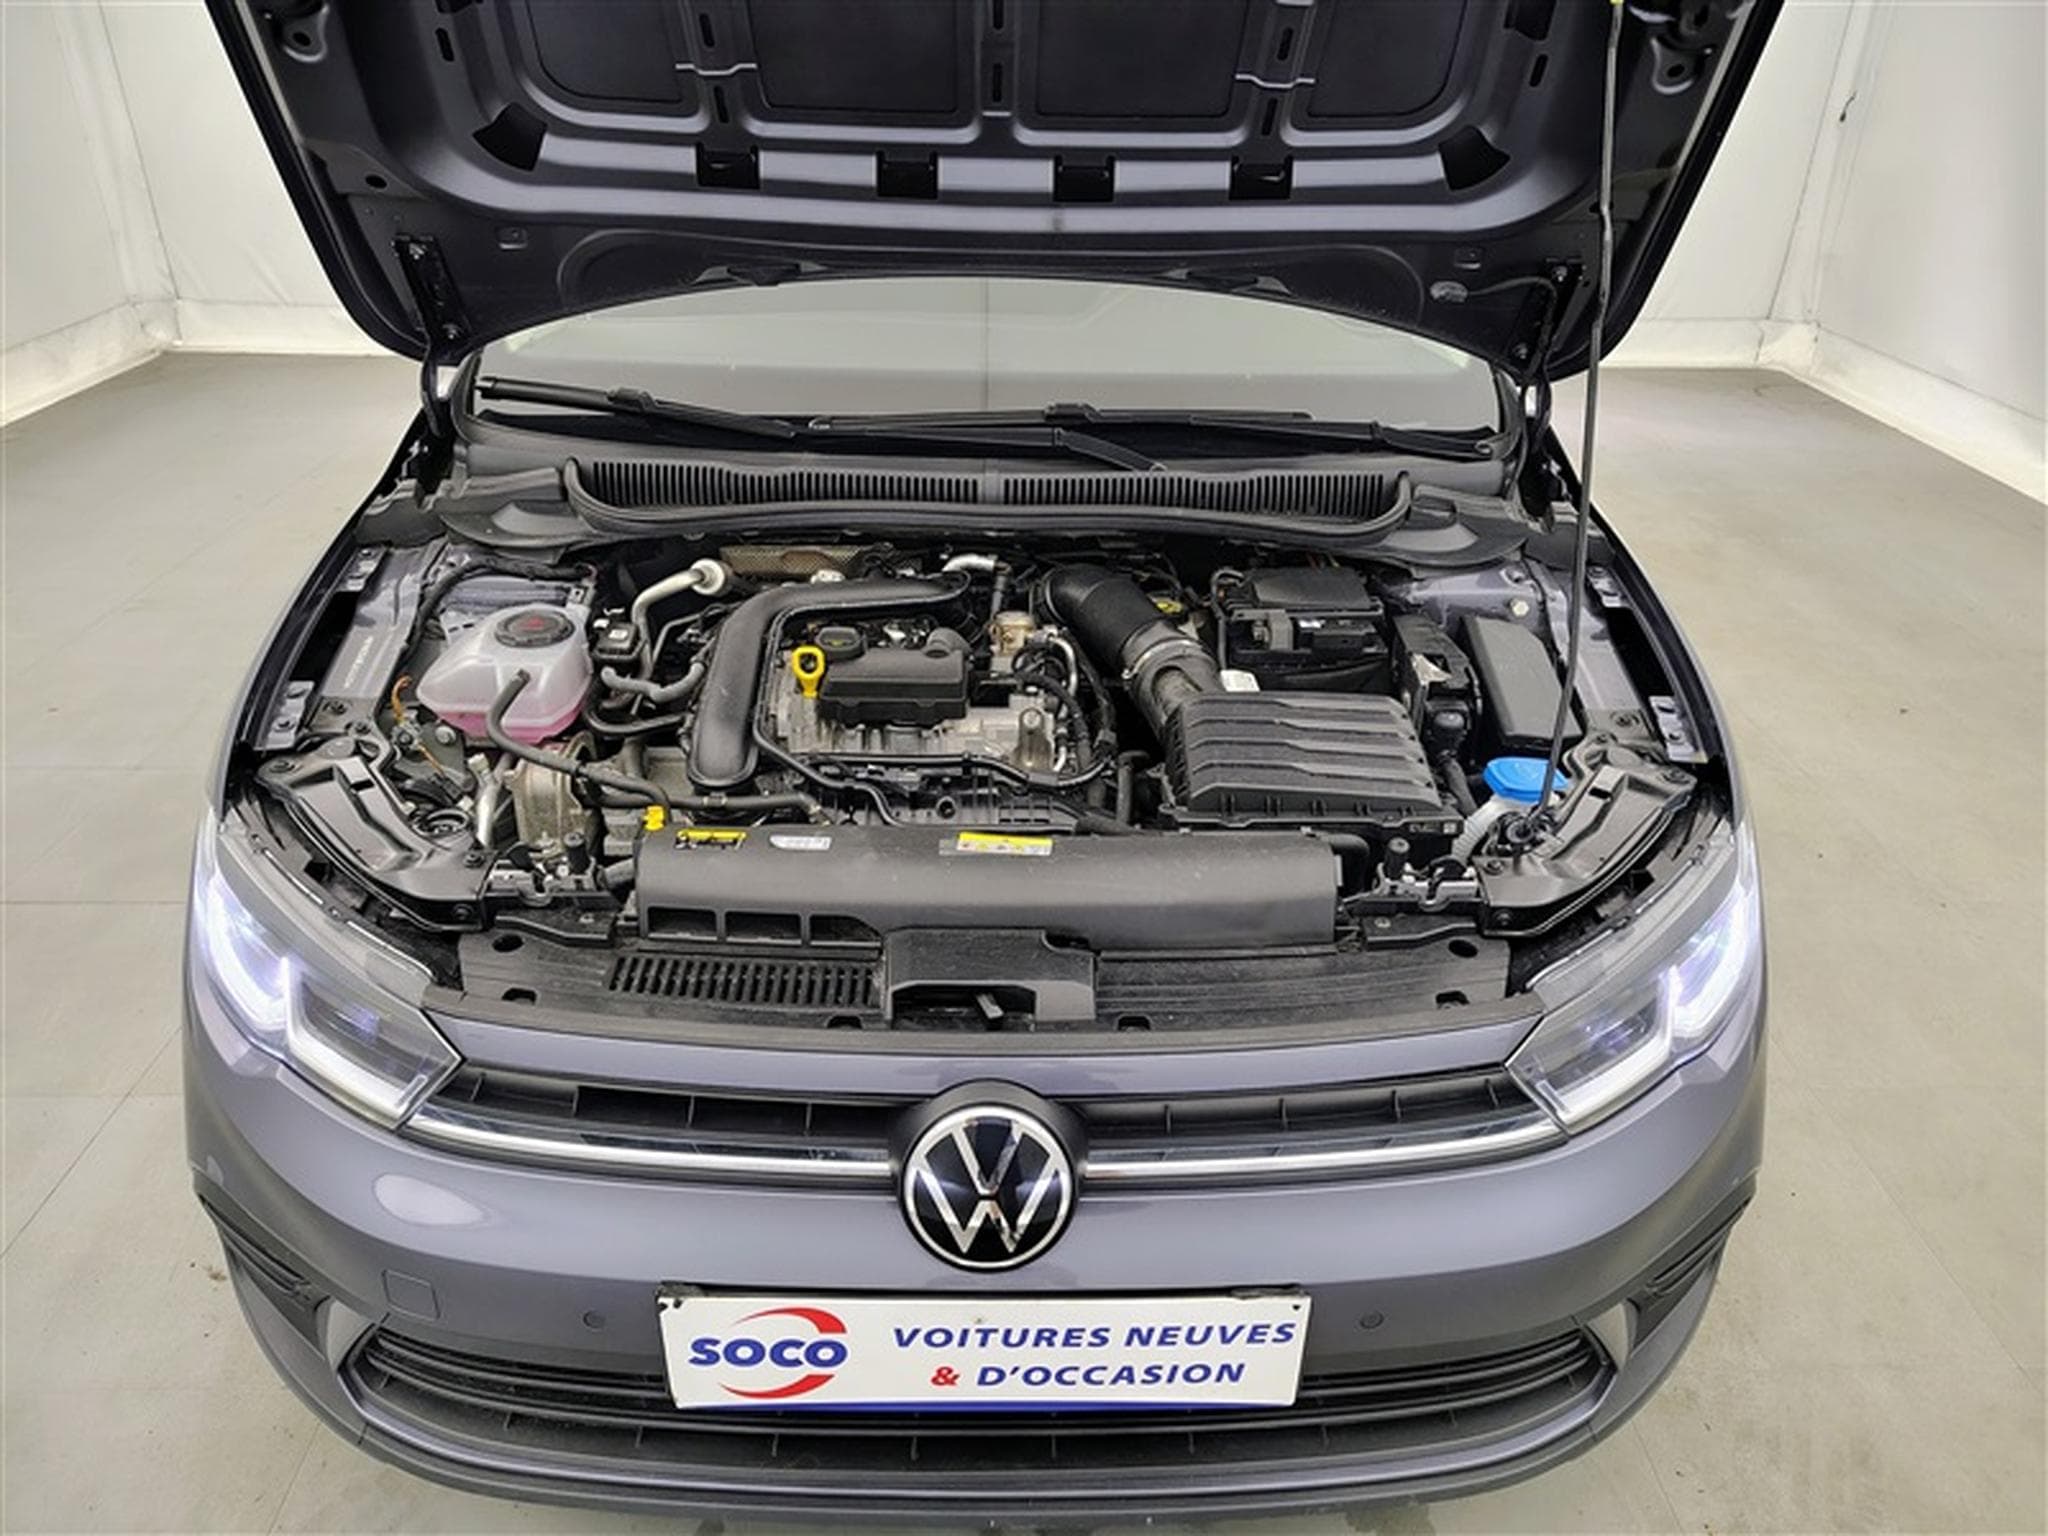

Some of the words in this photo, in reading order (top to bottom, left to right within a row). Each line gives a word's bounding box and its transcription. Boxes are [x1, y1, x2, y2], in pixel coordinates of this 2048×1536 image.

[893, 1327, 1110, 1349] VOITURES
[1124, 1323, 1297, 1347] NEUVES
[688, 1337, 848, 1369] SOCO
[930, 1365, 960, 1388] &
